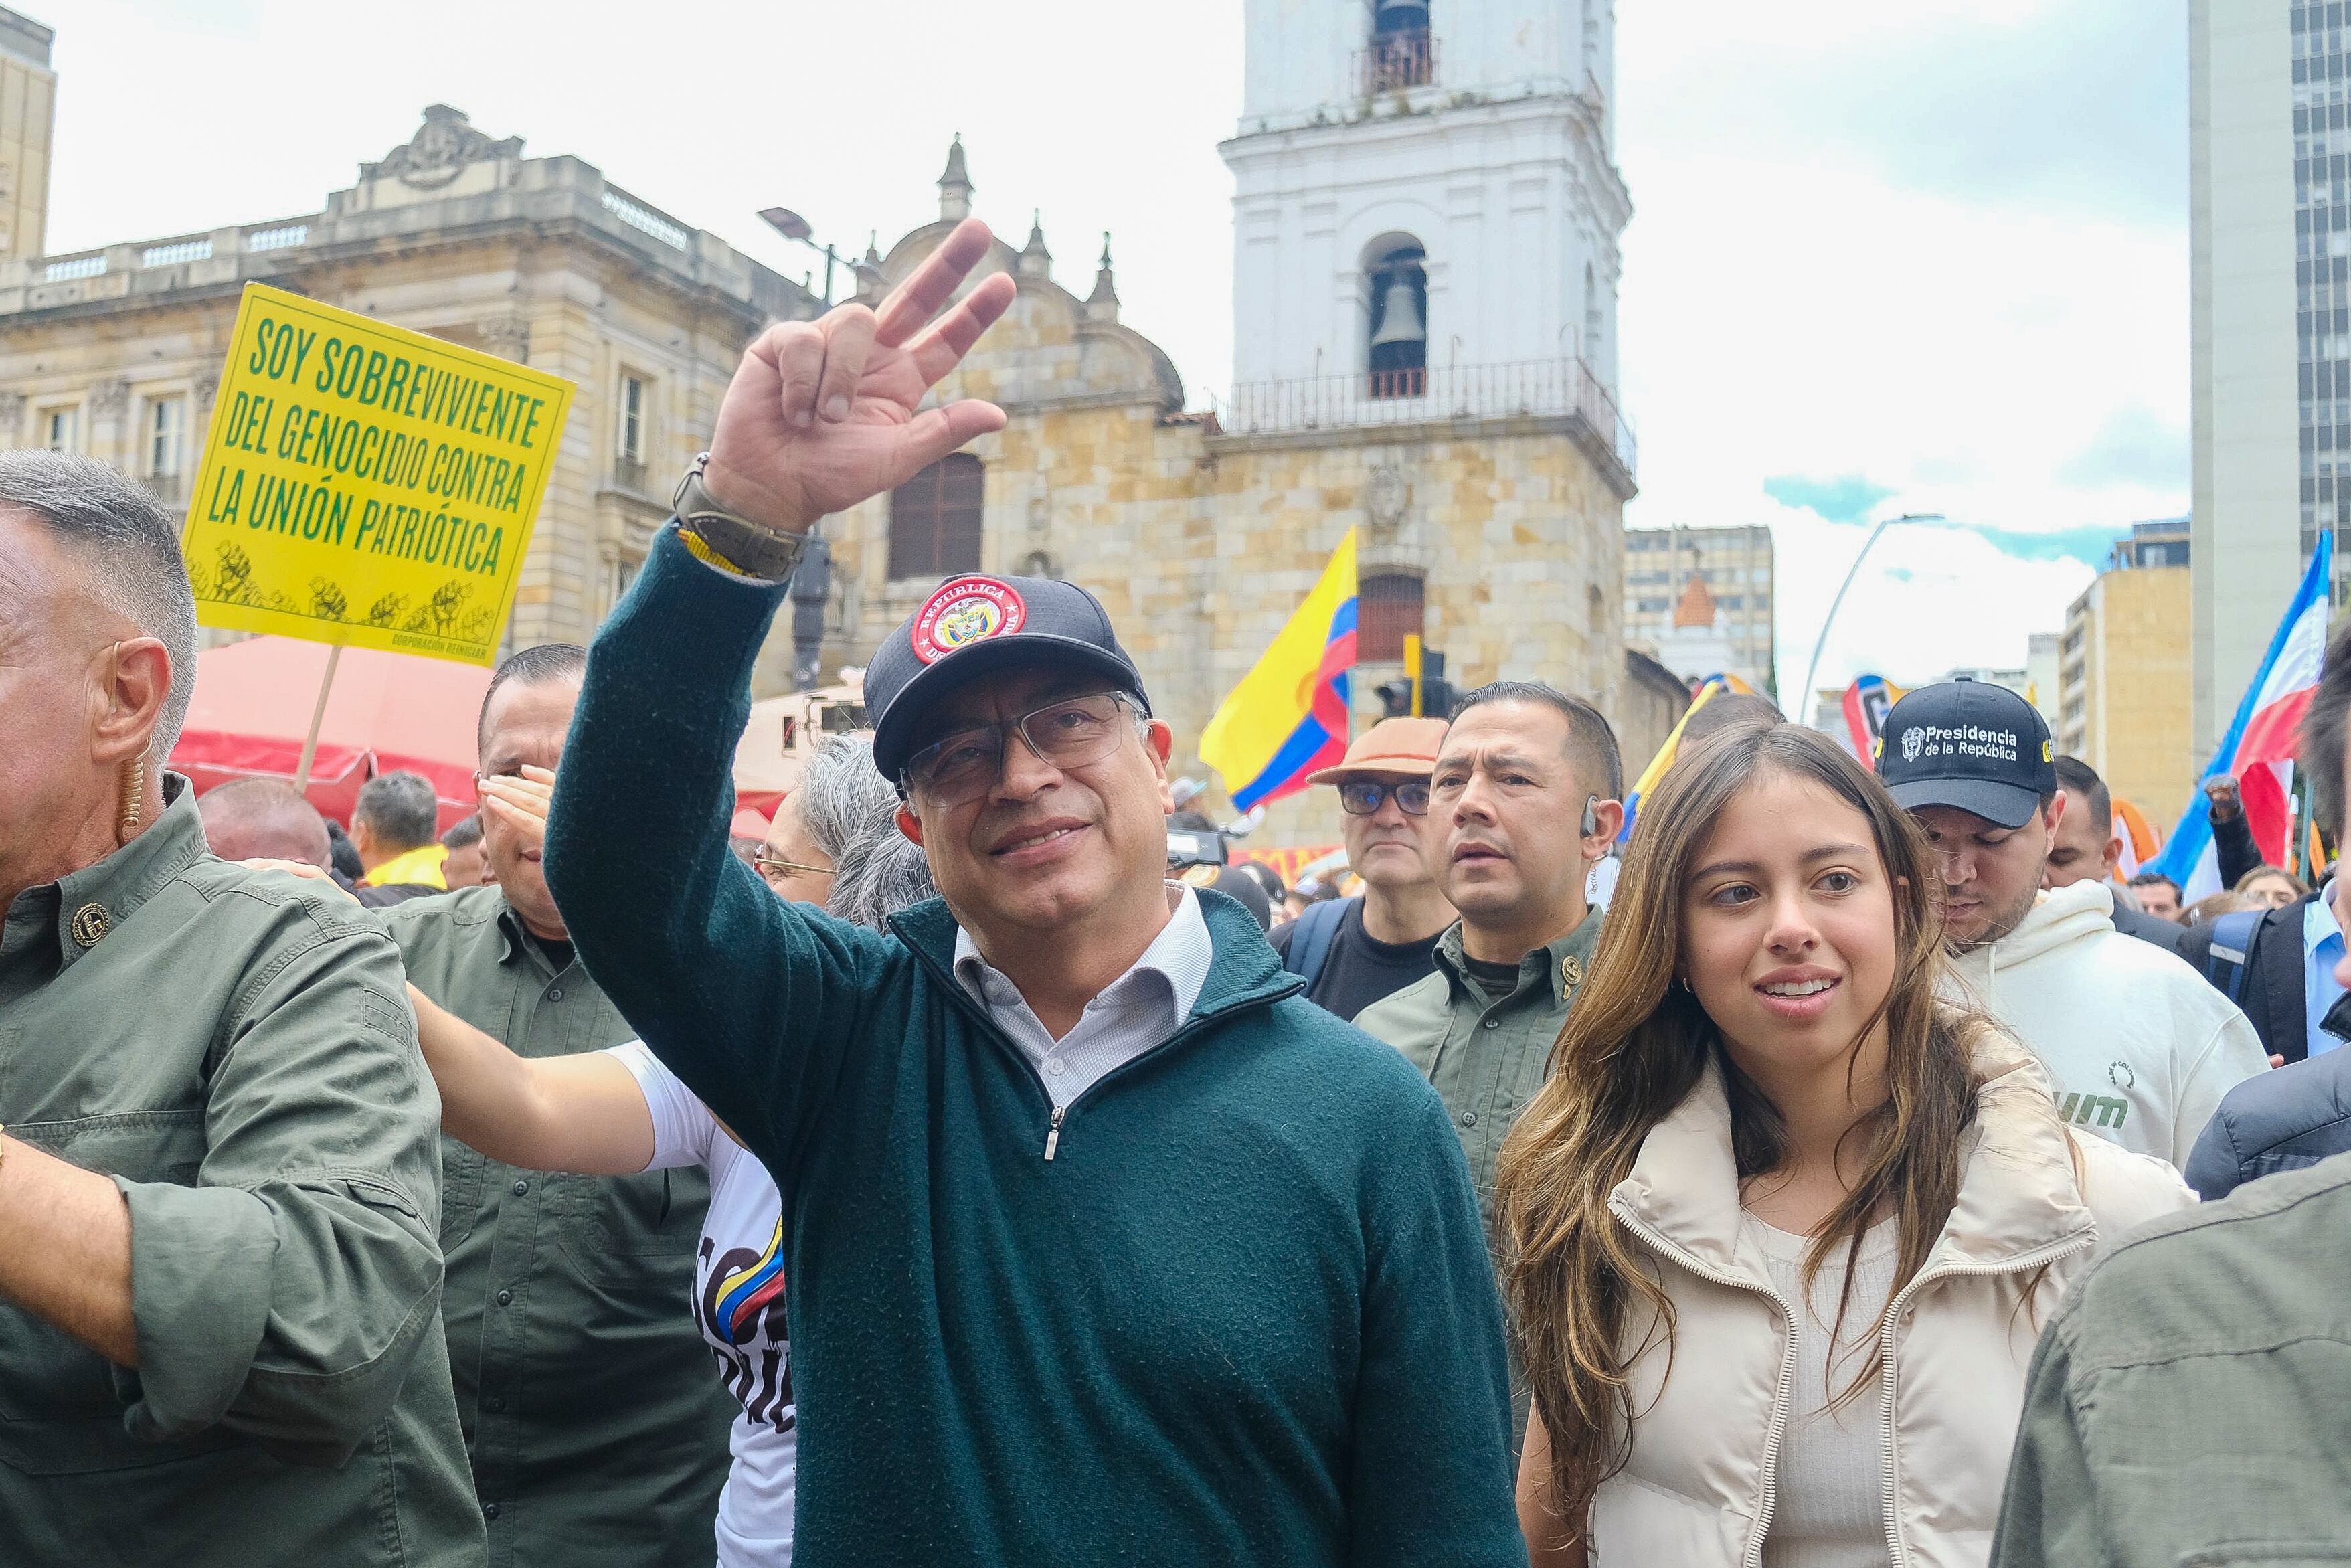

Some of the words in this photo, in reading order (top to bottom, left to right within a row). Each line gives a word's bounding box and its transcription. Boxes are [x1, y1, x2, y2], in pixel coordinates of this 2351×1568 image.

[250, 318, 317, 385] SOY
[315, 337, 545, 449] SOBREVIVIENTE
[224, 391, 274, 455] DEL
[278, 404, 429, 490] GENOCIDIO
[426, 443, 527, 514] CONTRA
[208, 466, 245, 525] LA
[248, 474, 354, 546] UNIÓN
[353, 499, 504, 577] PATRIÓTICA
[1925, 723, 2017, 747] Presidencia
[1925, 742, 1939, 757] de
[1942, 741, 1953, 755] la
[1958, 741, 2017, 762] República
